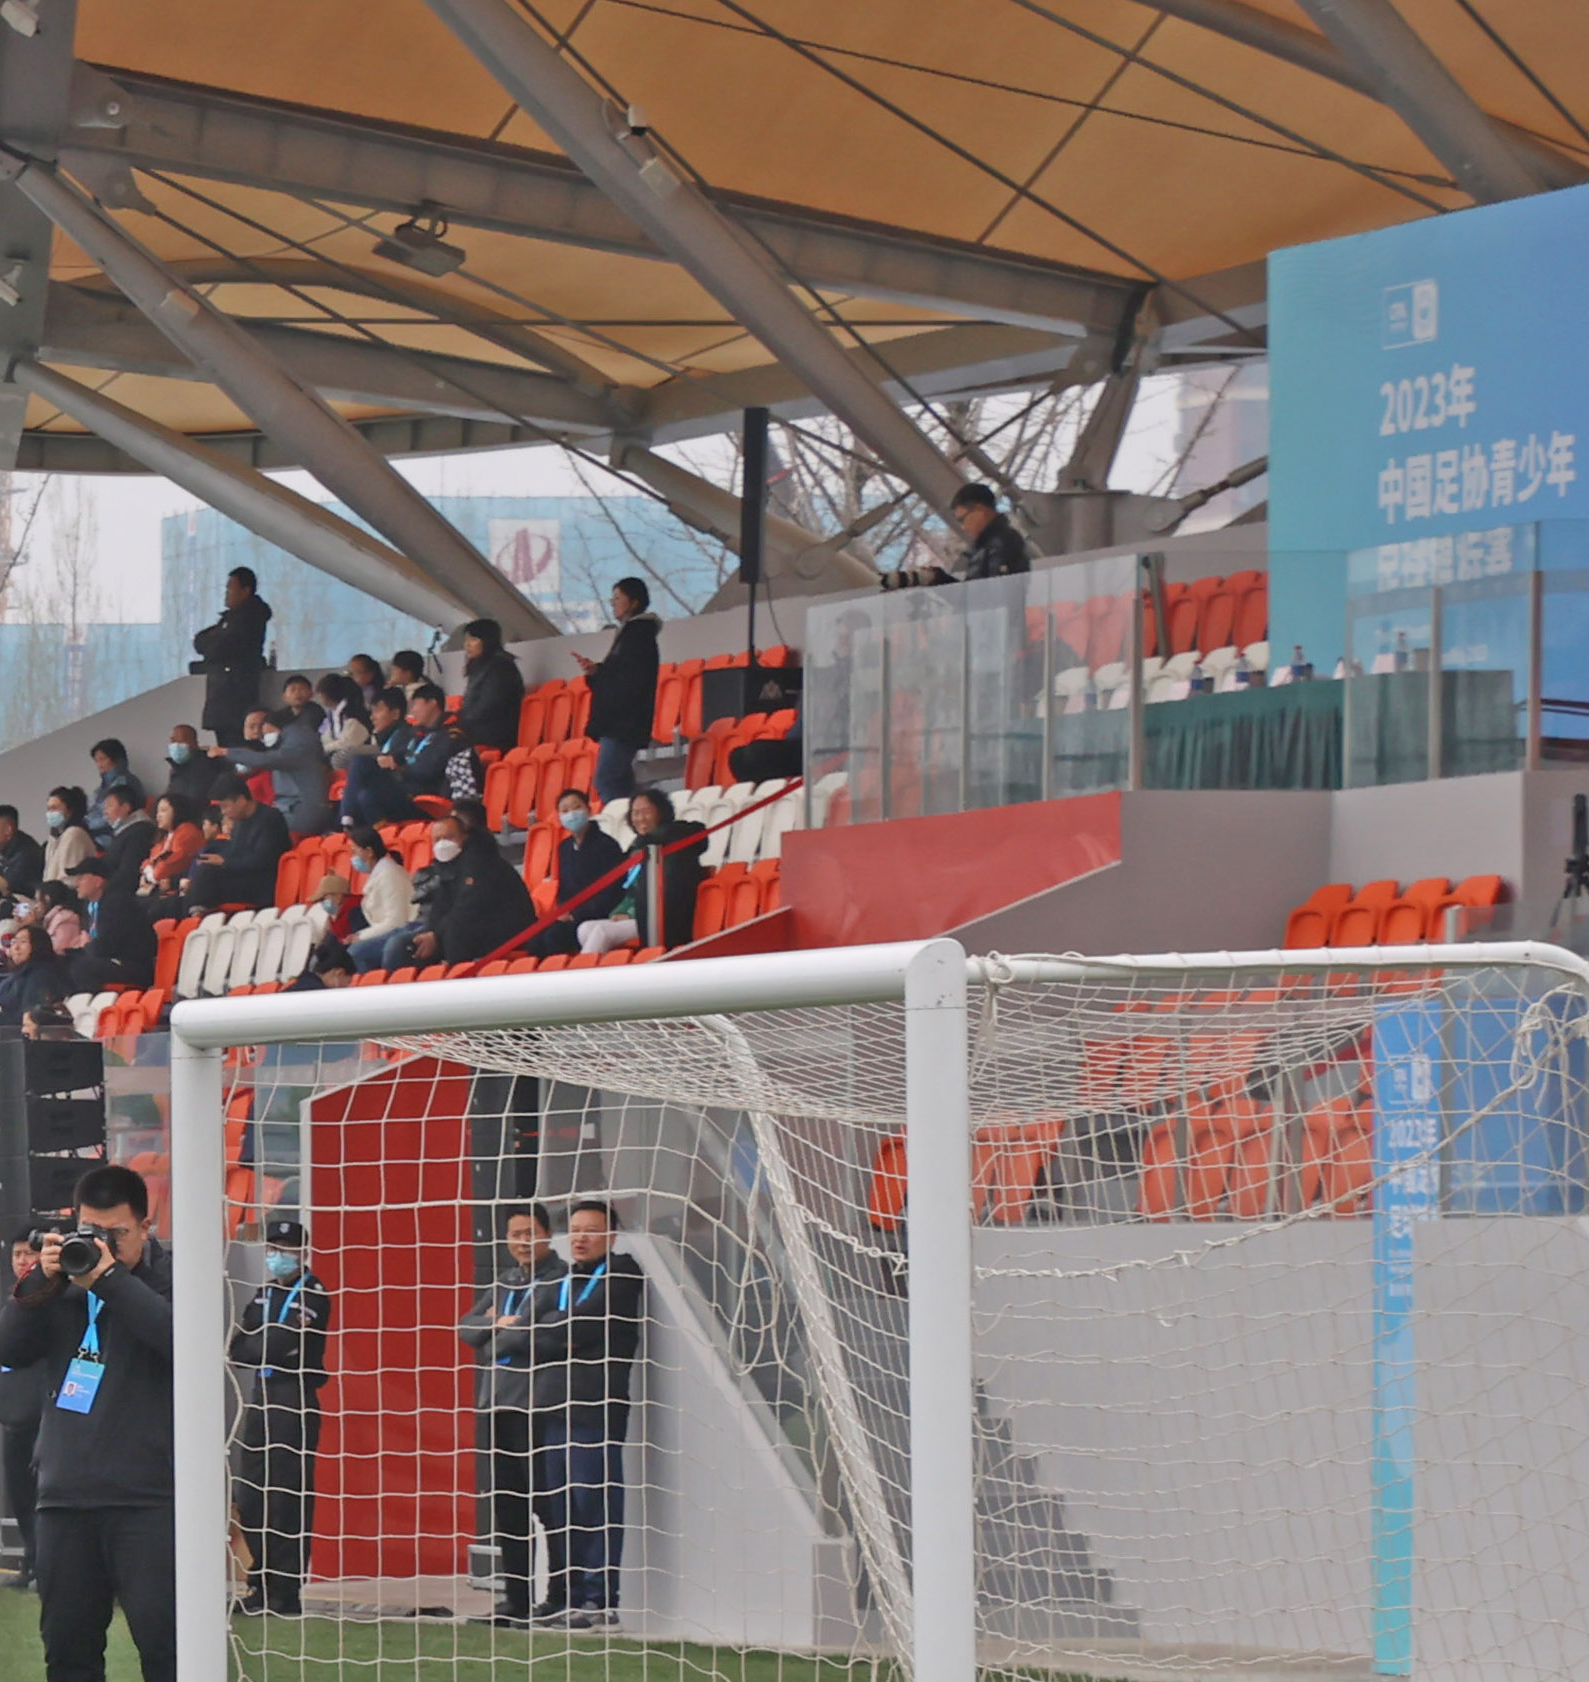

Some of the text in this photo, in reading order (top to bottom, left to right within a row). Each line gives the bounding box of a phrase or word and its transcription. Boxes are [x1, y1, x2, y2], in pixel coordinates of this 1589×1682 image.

[1379, 363, 1476, 436] 2023年
[1378, 430, 1576, 525] 中国足协青少年
